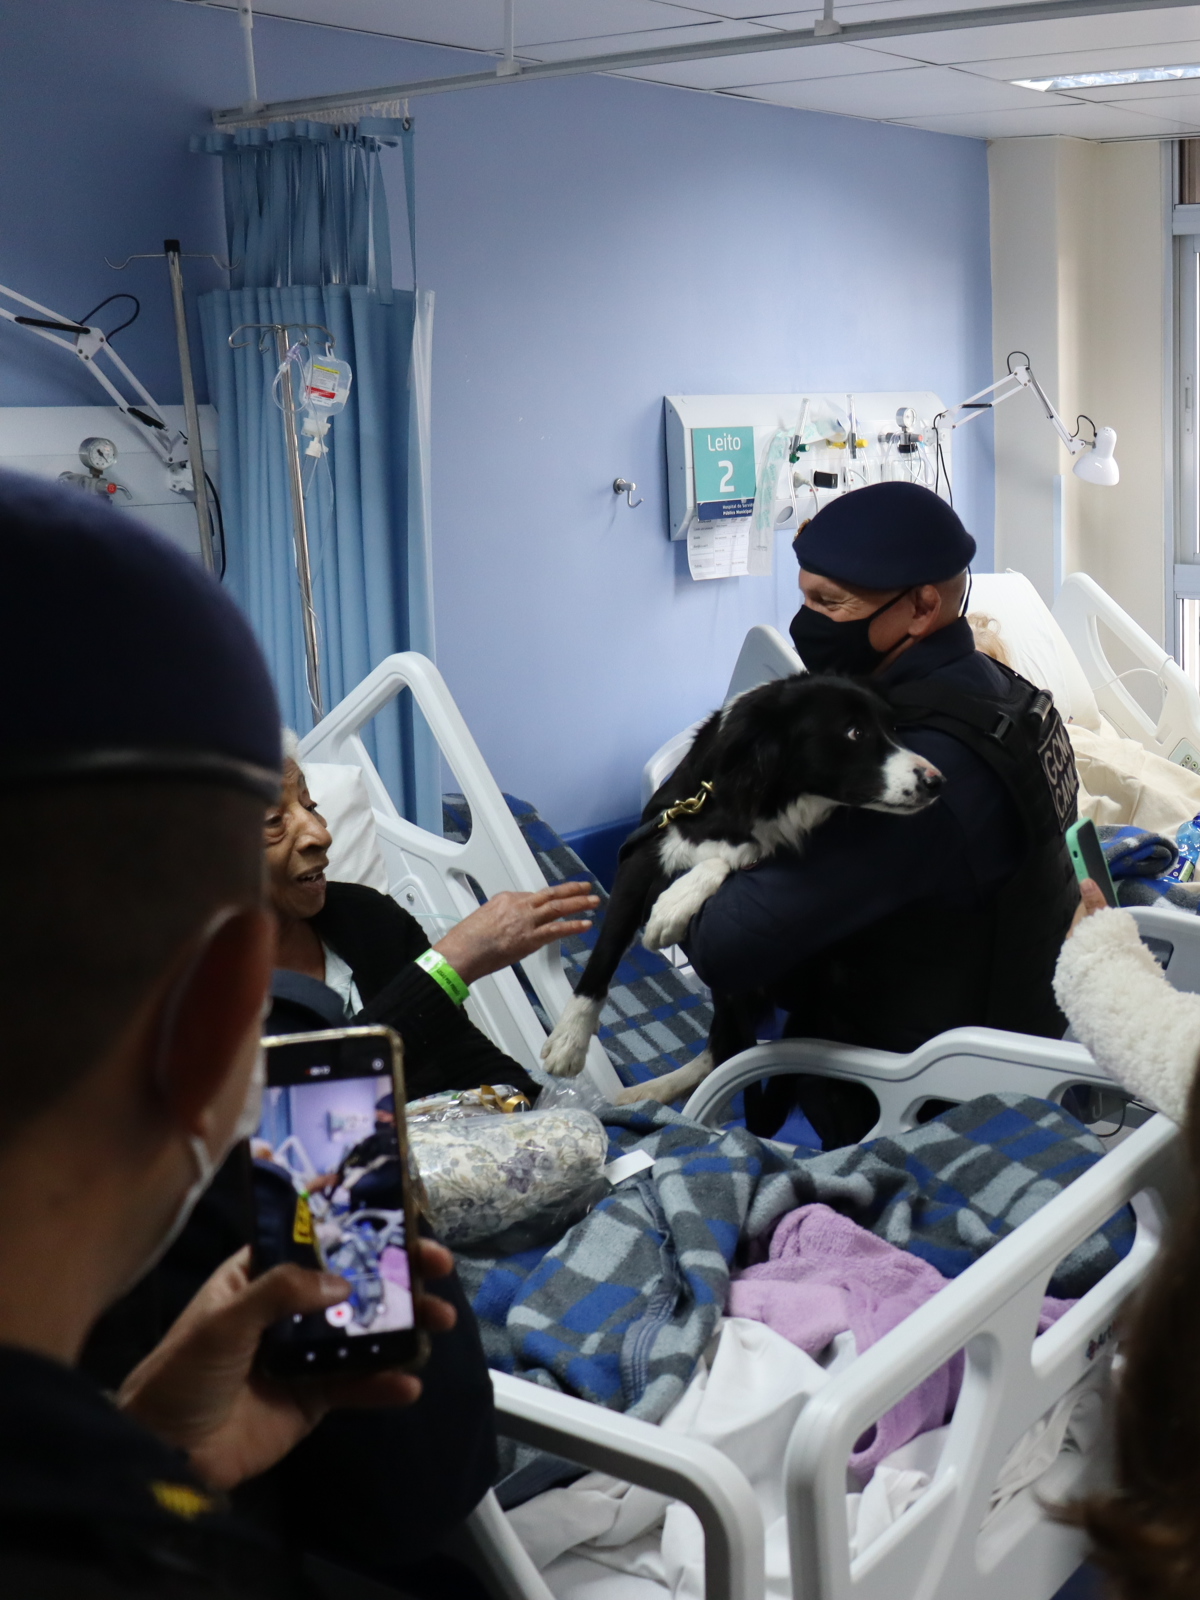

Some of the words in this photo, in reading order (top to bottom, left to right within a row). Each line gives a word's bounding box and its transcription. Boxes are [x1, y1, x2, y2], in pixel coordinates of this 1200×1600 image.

[707, 432, 741, 452] Leito
[717, 460, 735, 493] 2
[1044, 724, 1075, 786] GCM
